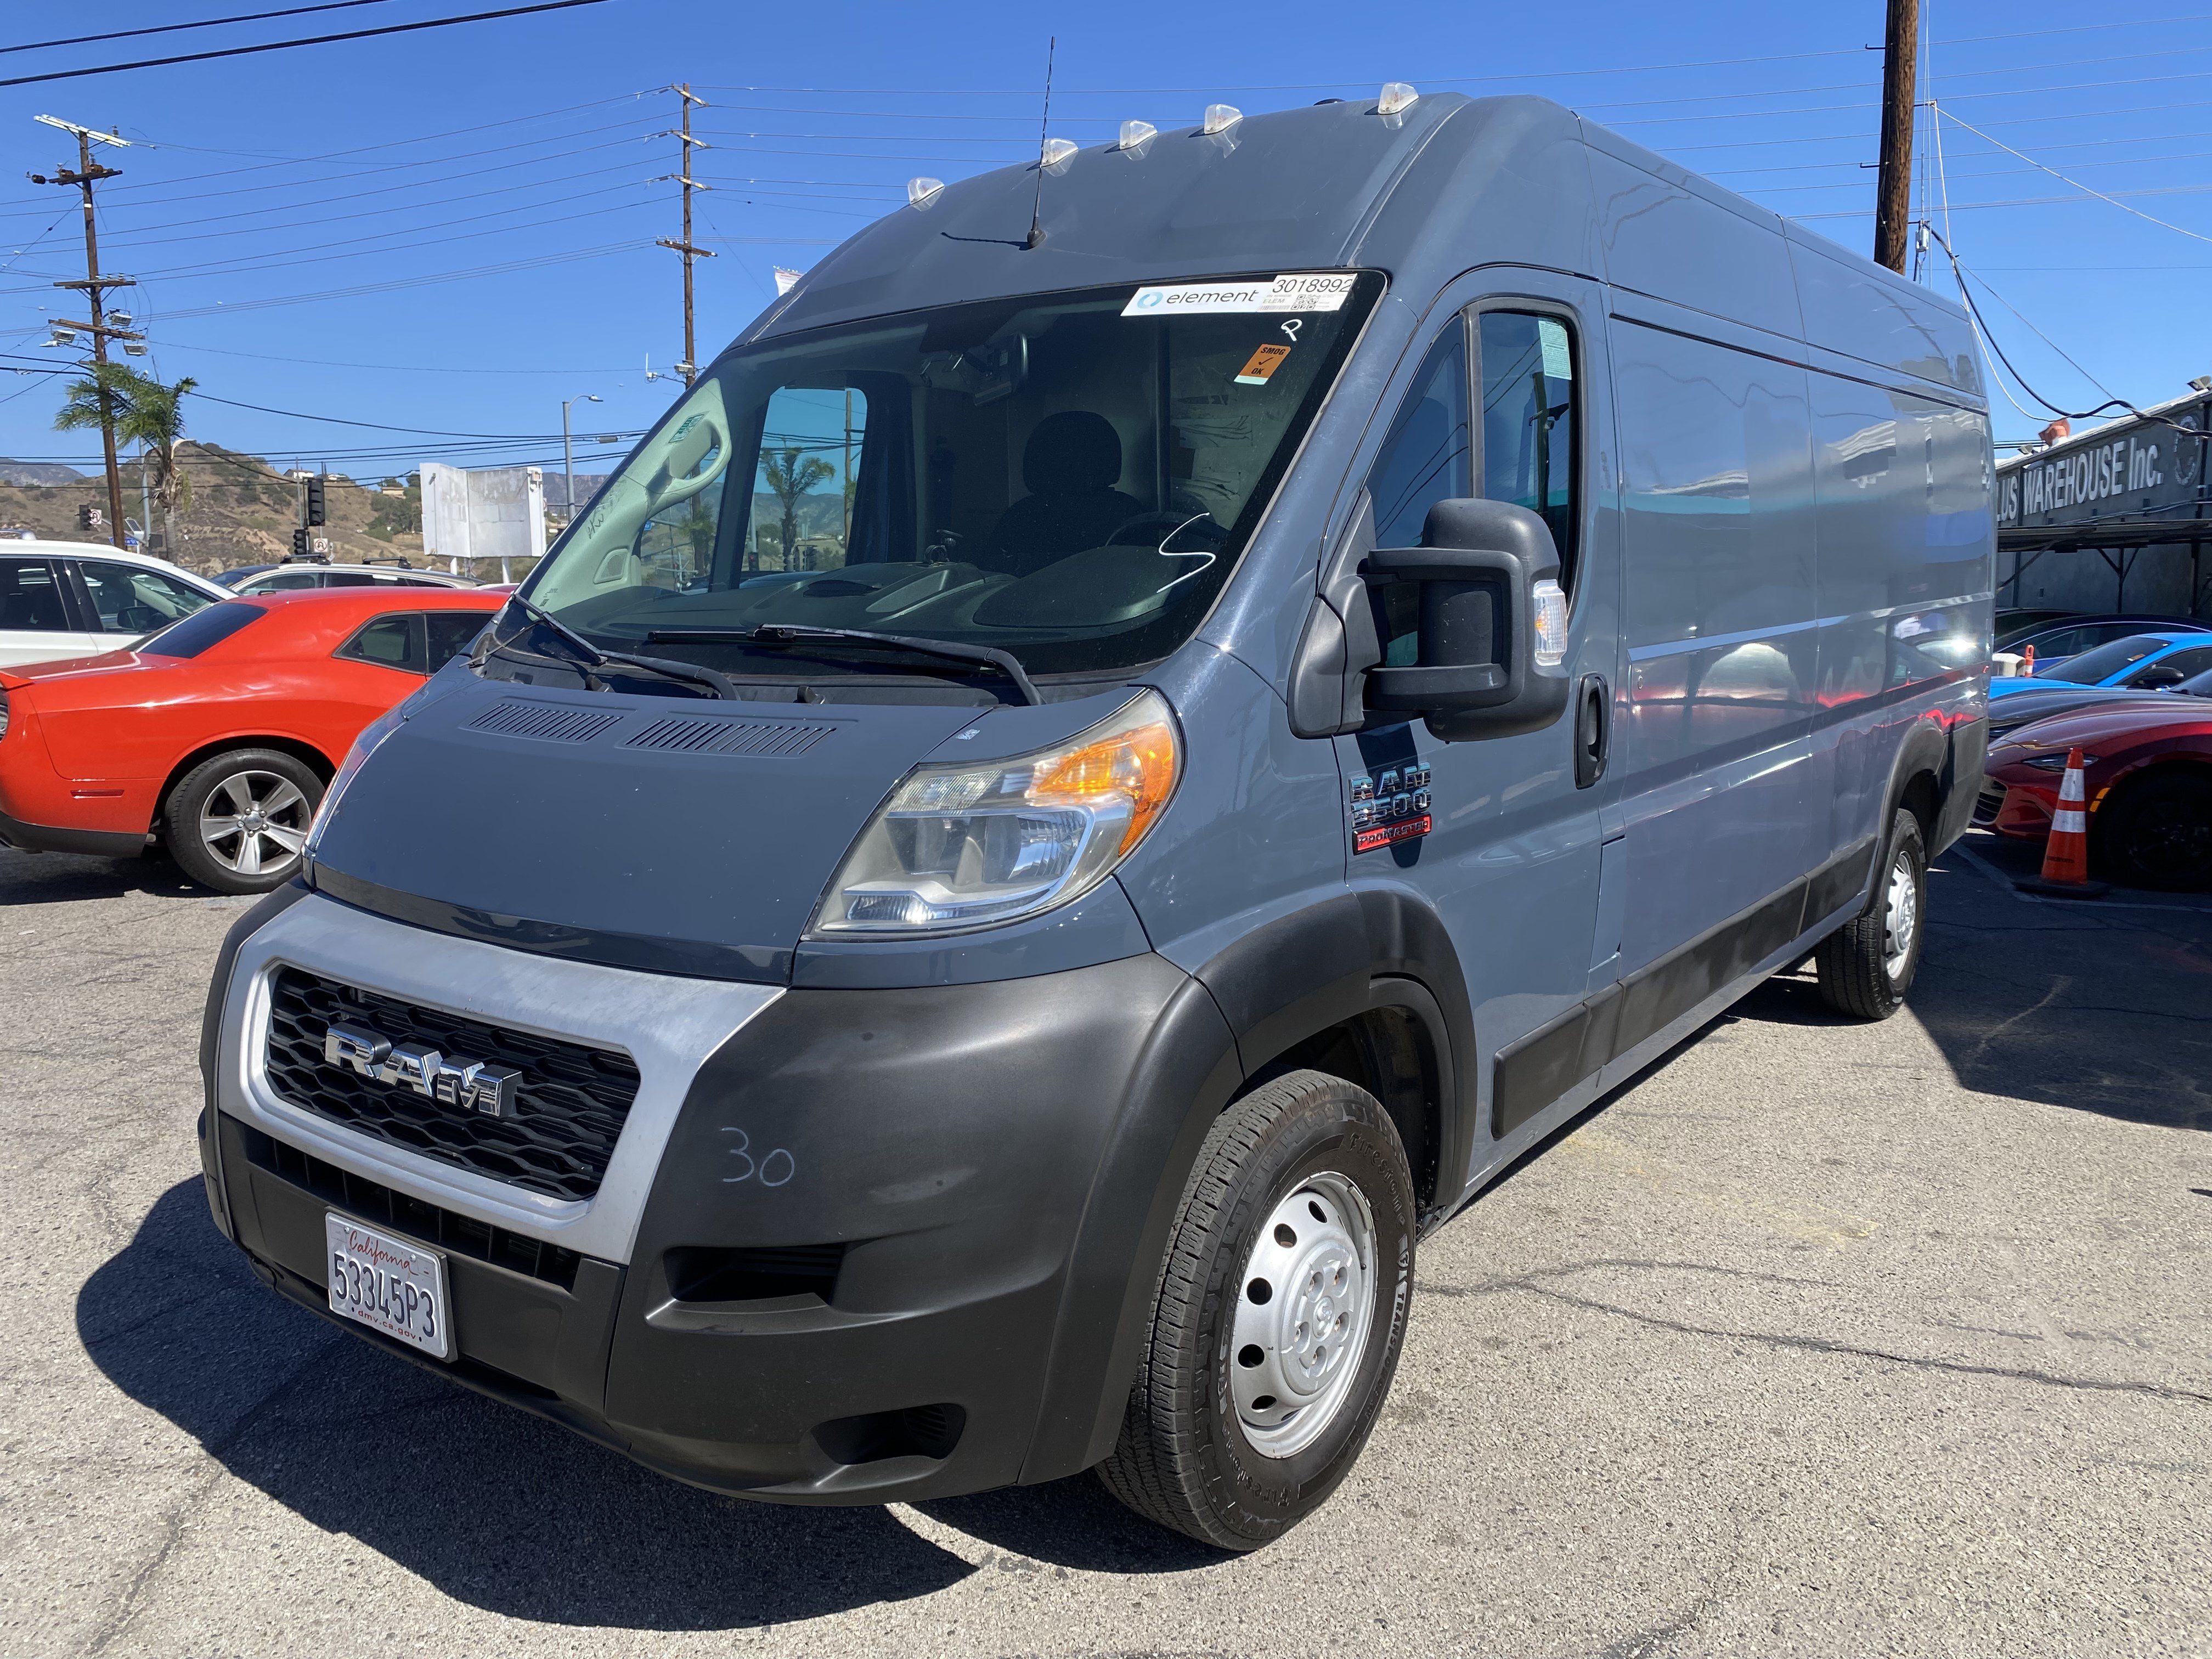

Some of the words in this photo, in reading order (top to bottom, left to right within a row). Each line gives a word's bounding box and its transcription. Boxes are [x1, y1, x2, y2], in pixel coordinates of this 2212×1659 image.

[1166, 290, 1259, 303] element
[1272, 279, 1352, 293] 3018992
[1260, 347, 1286, 356] SMOG
[2023, 441, 2125, 516] WAREHOUSE
[2128, 437, 2164, 492] Inc.
[1348, 762, 1431, 803] RAM
[325, 1018, 523, 1118] RAM
[721, 1127, 795, 1187] 30
[349, 1230, 419, 1276] California
[334, 1252, 436, 1338] 53345P3
[358, 1310, 416, 1340] dmv.ca.gov
